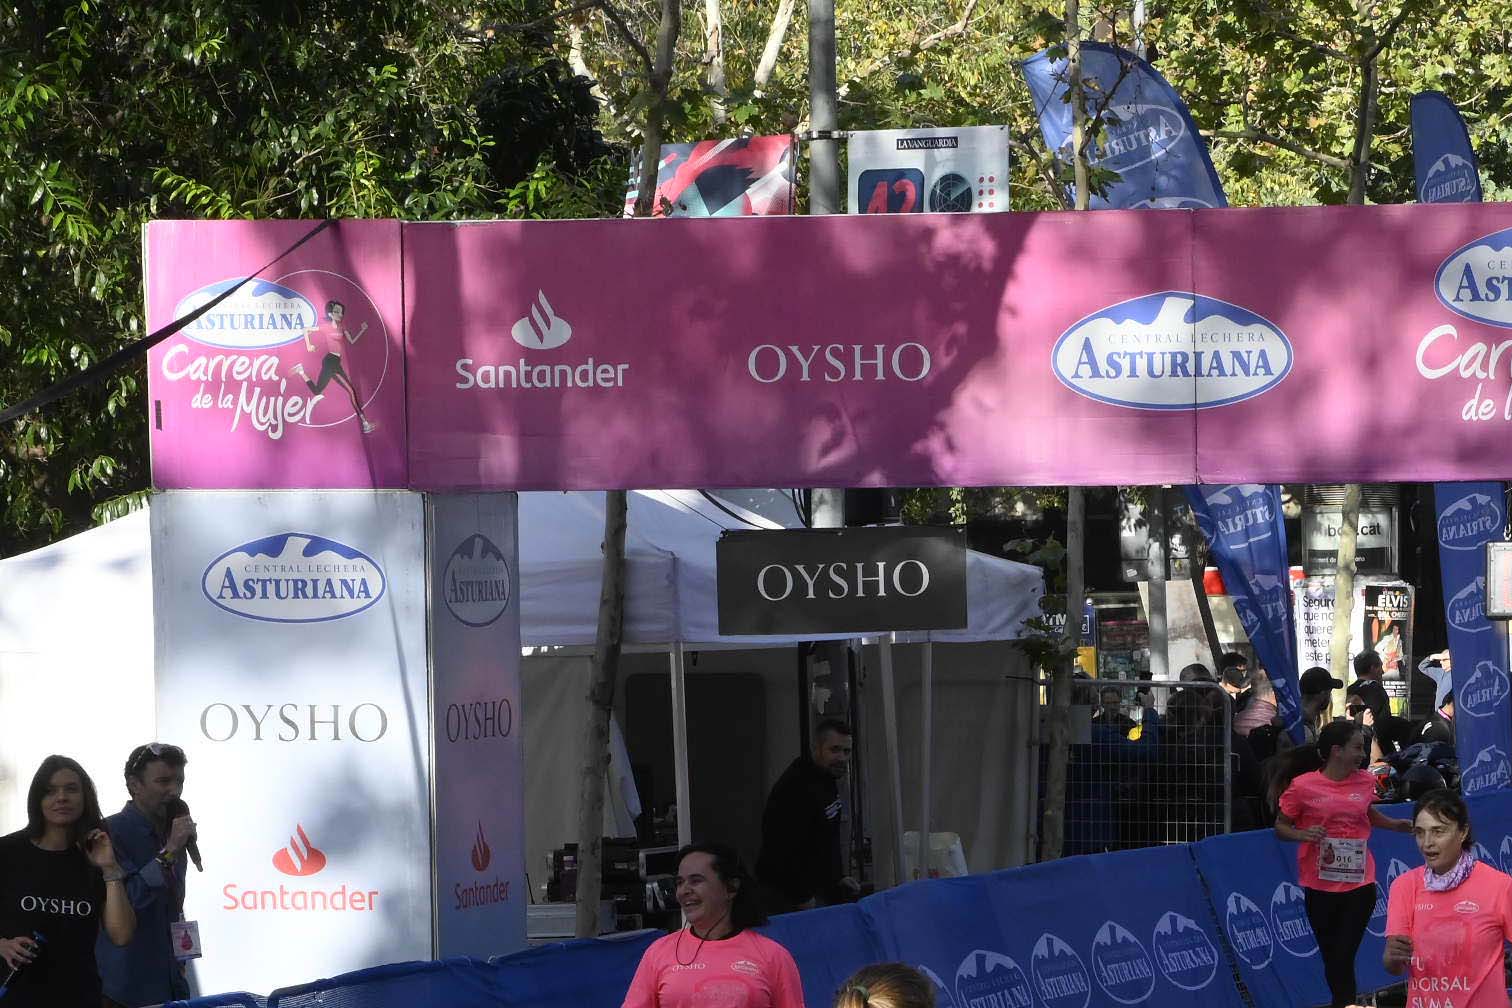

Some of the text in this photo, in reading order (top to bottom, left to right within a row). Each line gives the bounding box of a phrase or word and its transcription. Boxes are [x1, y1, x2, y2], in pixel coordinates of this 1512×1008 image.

[1107, 329, 1266, 346] CENTRAL LECHERA
[162, 344, 280, 382] Carrera
[455, 356, 629, 390] Santander
[747, 342, 932, 383] OYSHO
[1070, 345, 1274, 382] ASTURIANA
[191, 378, 325, 441] de la Mujer
[1461, 381, 1496, 422] de
[217, 567, 373, 600] ASTURIANA
[244, 563, 366, 573] CENTRAL LECHERA
[757, 559, 930, 601] OYSHO
[449, 573, 507, 603] ASTURIANA
[1378, 595, 1409, 608] ELVIS
[200, 702, 388, 743] OYSHO
[446, 698, 512, 744] OYSHO
[21, 896, 92, 917] OYSHO
[222, 884, 379, 911] Santander
[455, 877, 510, 911] Santander
[1410, 976, 1471, 992] DORSAL
